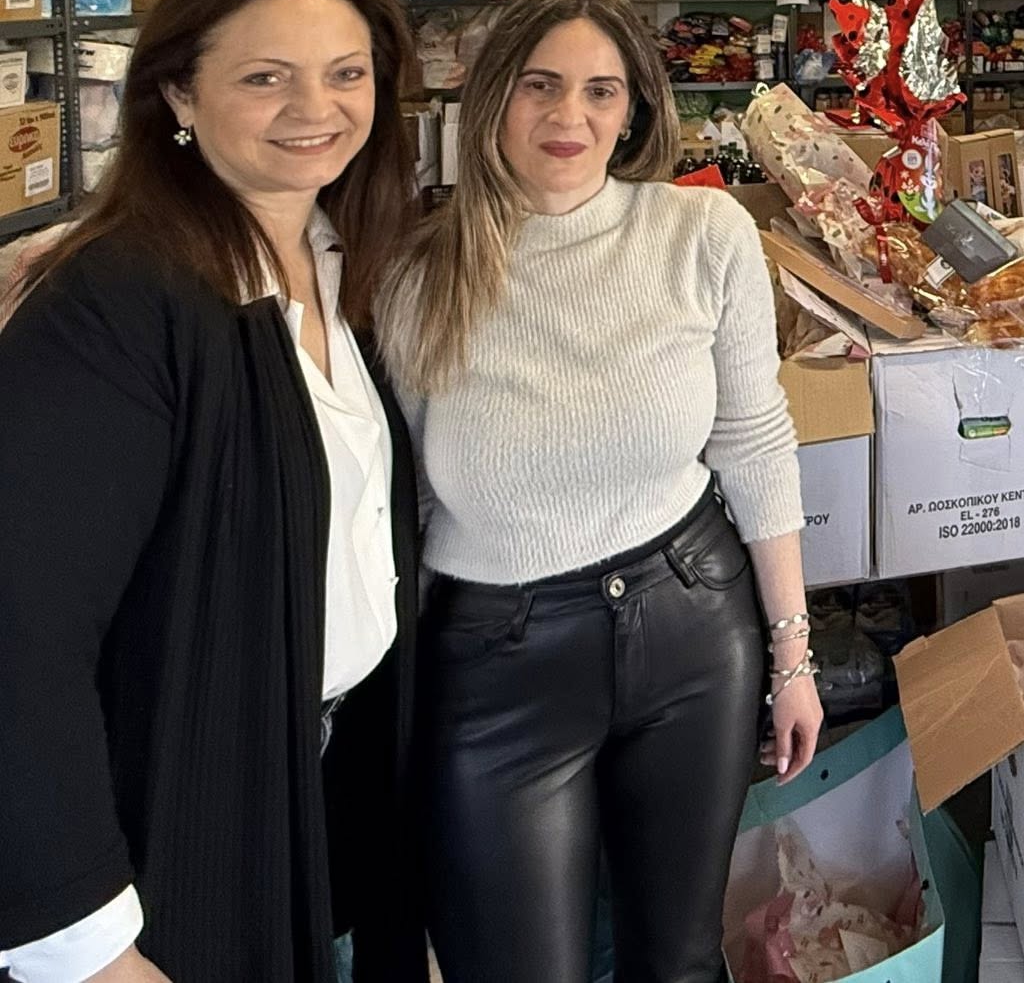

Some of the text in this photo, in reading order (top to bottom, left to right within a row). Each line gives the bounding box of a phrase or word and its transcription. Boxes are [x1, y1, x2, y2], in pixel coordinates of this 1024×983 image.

[908, 503, 926, 515] ΑΡ.
[928, 493, 999, 512] ΩΟΣΚΟΠΙΚΟΥ
[803, 513, 830, 526] ΡΟΥ
[960, 511, 974, 521] EL
[982, 507, 1000, 518] 276
[939, 516, 1021, 539] ISO 22000:2018
